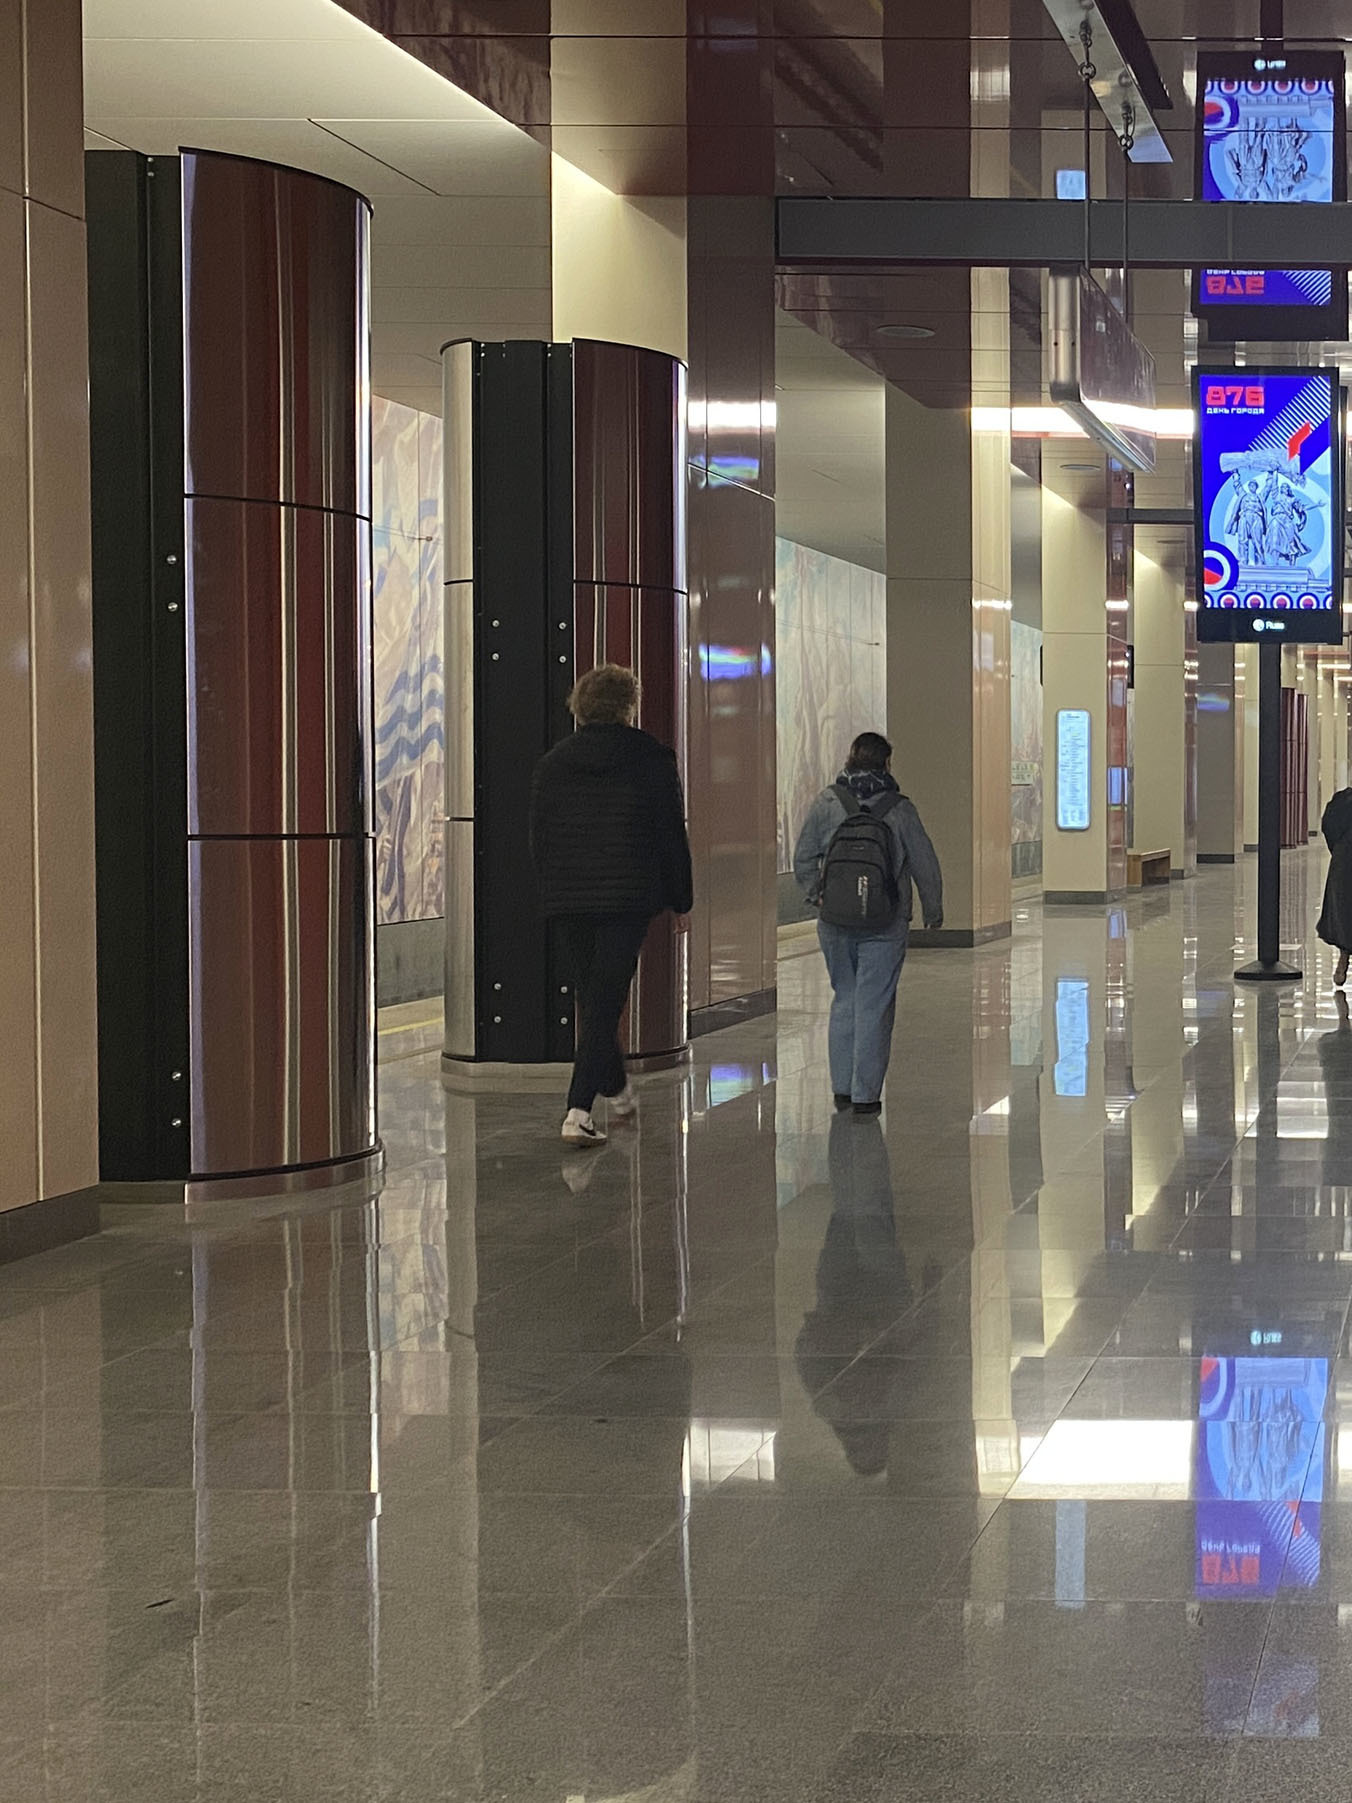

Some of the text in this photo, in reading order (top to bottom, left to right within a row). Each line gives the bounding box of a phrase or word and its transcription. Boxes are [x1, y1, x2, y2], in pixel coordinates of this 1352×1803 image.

[1206, 386, 1265, 406] 876
[1206, 407, 1265, 415] ДЕНЬ ГОРОДА
